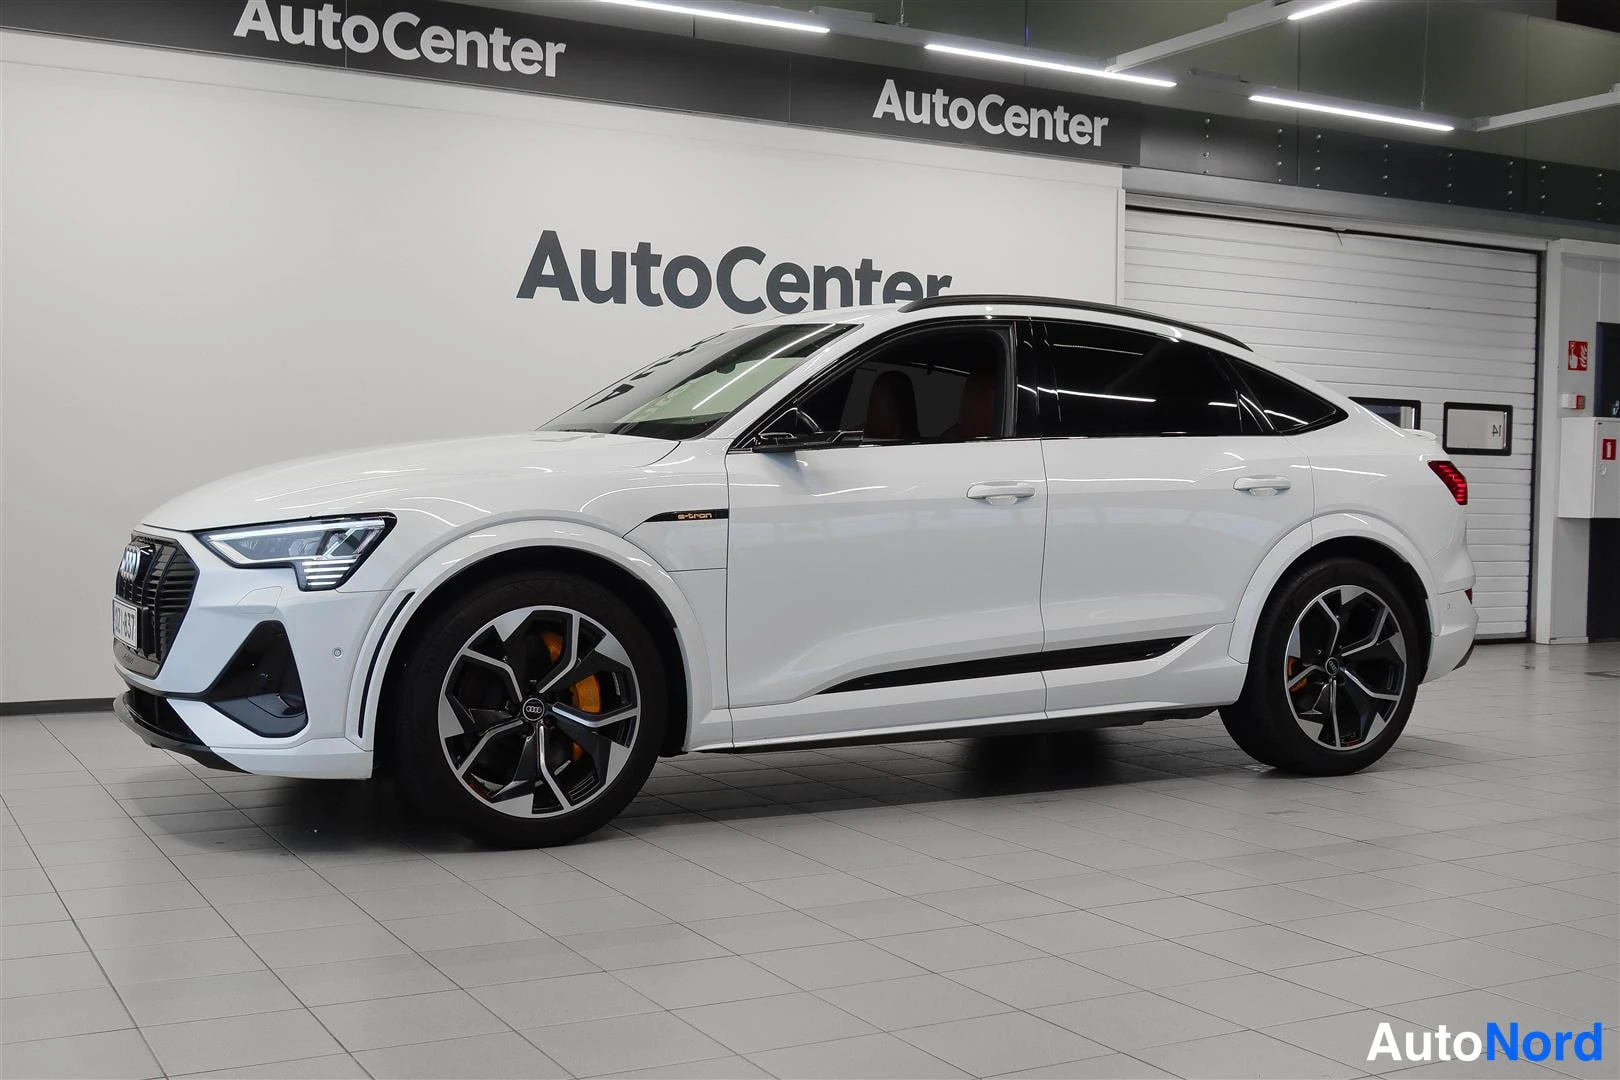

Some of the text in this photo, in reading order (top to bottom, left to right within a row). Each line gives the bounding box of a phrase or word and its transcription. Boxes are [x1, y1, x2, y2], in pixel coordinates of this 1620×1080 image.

[233, 0, 567, 77] AutoCenter
[872, 79, 1109, 147] AutoCenter
[516, 229, 953, 315] AutoCenter
[677, 512, 713, 520] e-tron
